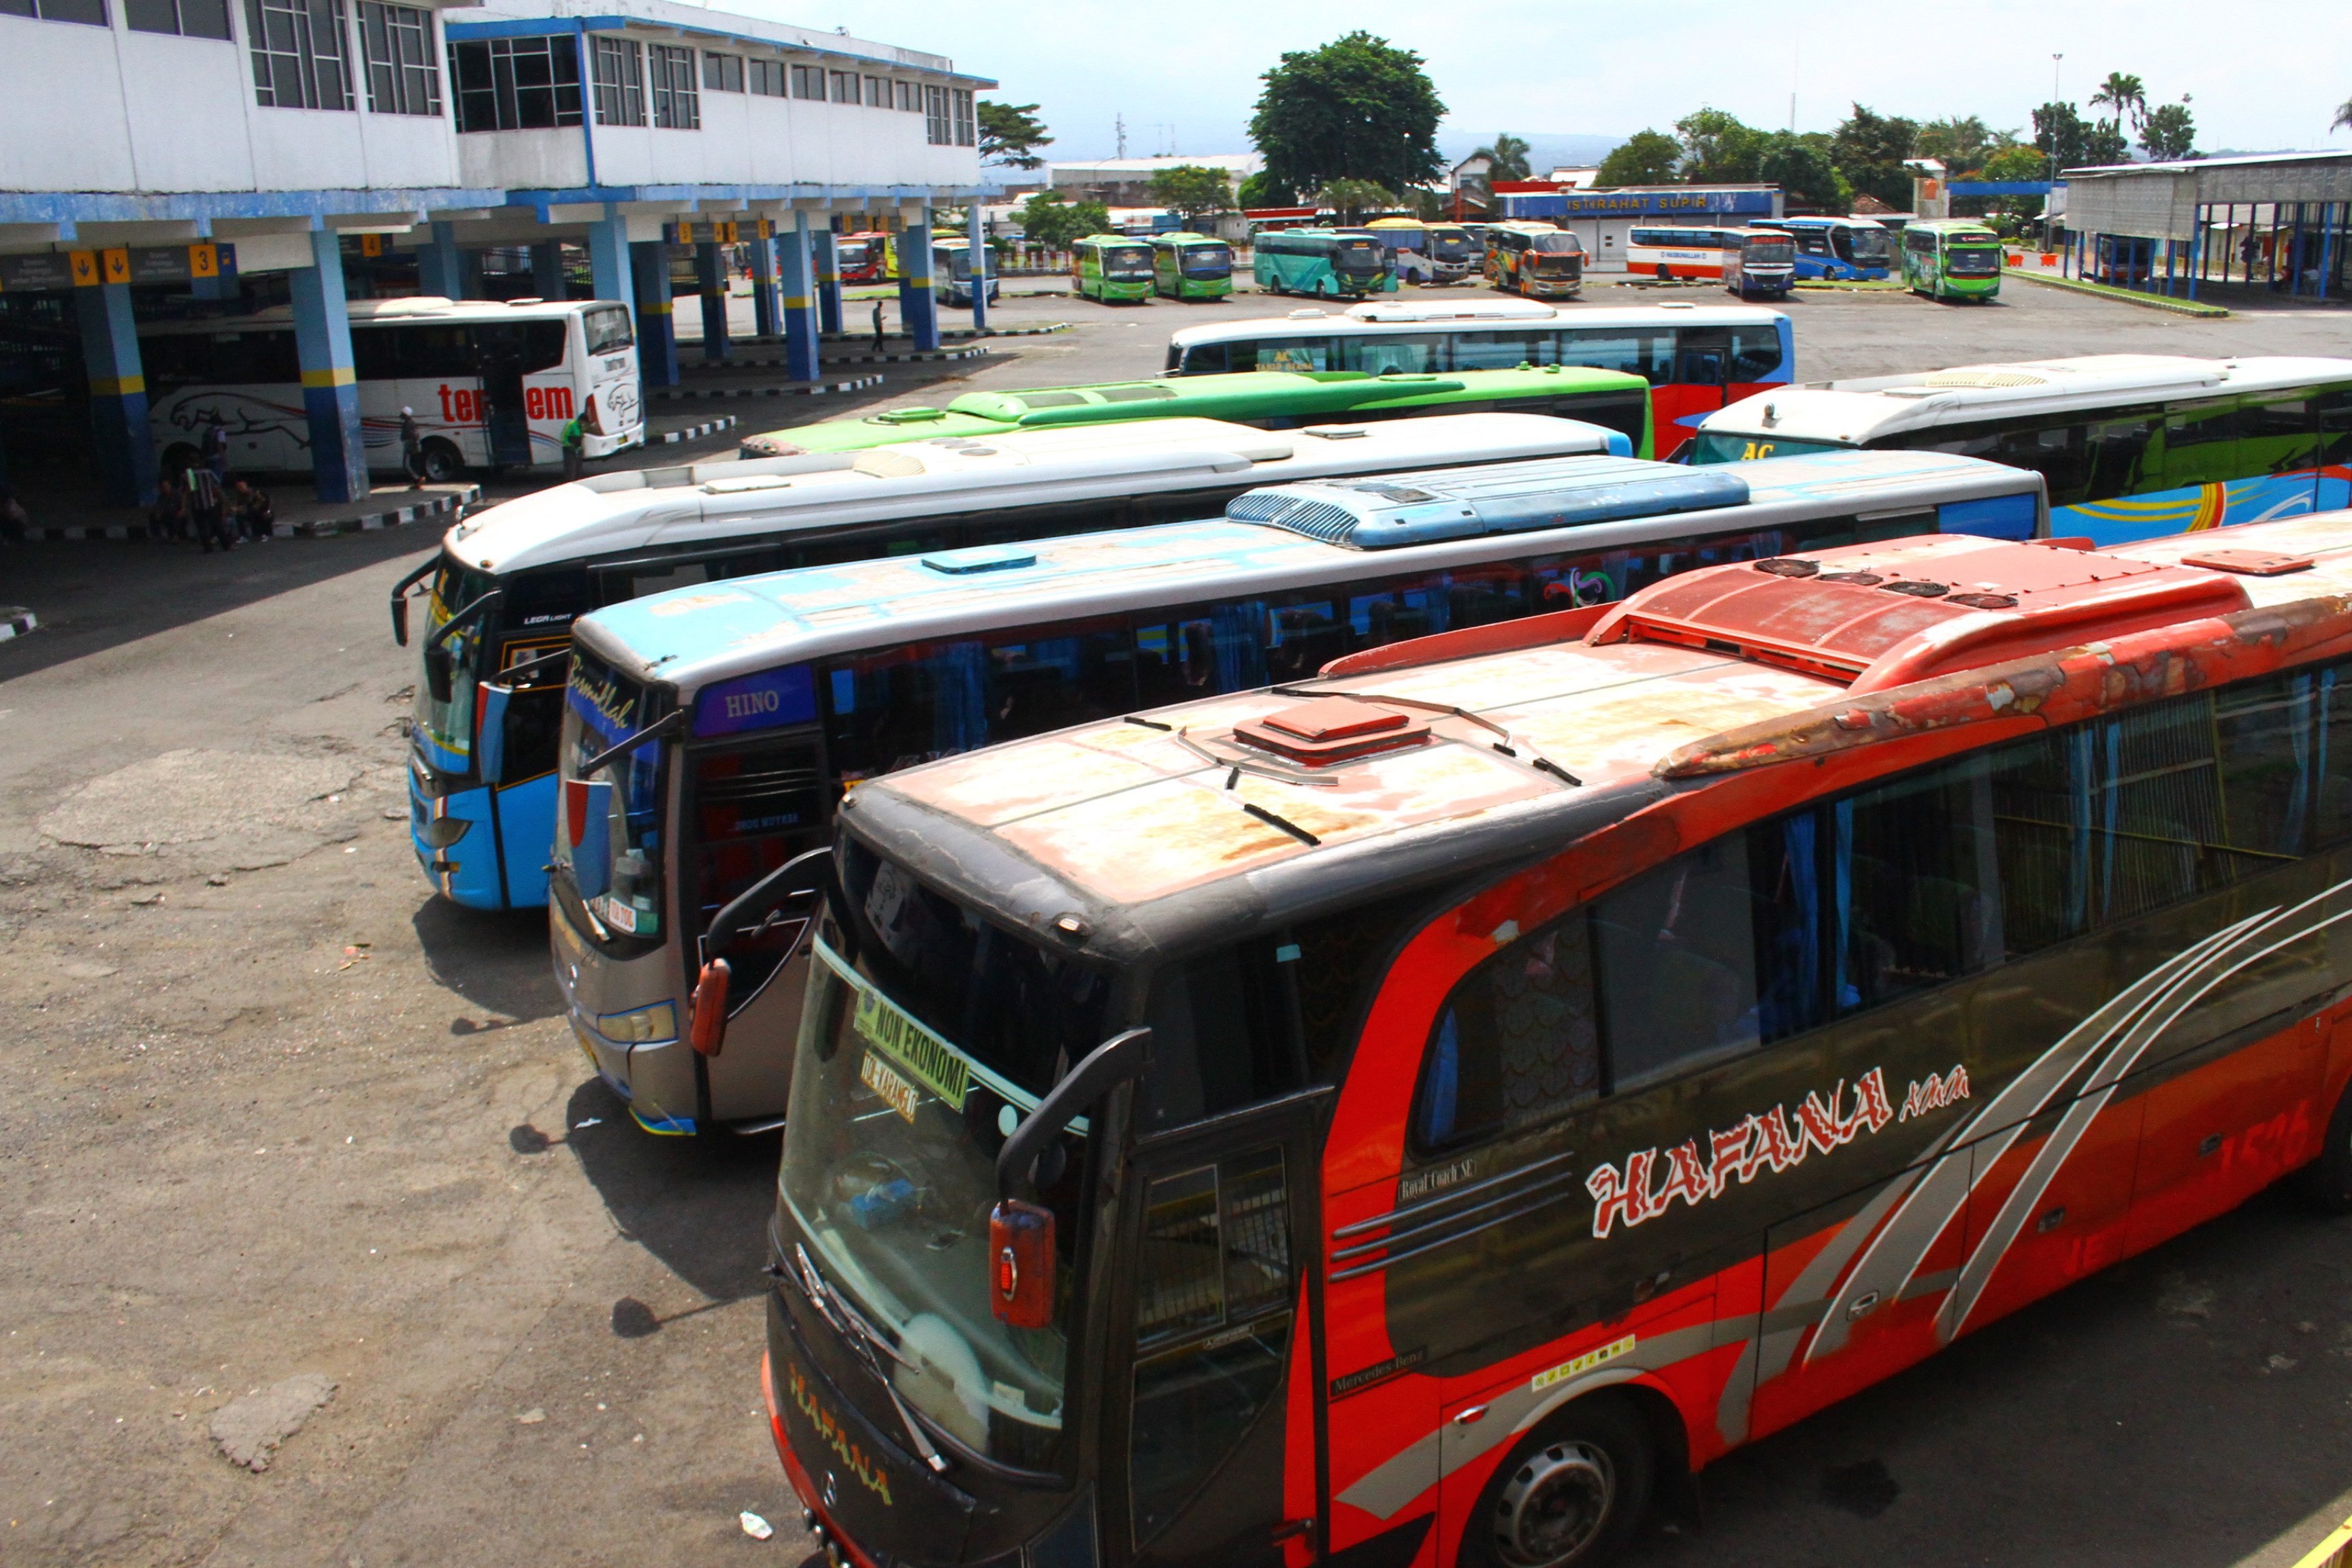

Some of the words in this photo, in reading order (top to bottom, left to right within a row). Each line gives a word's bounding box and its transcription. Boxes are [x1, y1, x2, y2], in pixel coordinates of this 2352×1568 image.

[1567, 198, 1650, 210] ISTIRAHAT
[1659, 197, 1707, 209] SUPIR
[198, 250, 208, 271] 3
[369, 237, 376, 251] 4
[1740, 442, 1775, 461] AC
[568, 654, 634, 729] Bismillah
[725, 689, 779, 718] HINO
[876, 1001, 904, 1051] NON
[902, 1022, 966, 1099] EKONOMI
[1586, 1066, 1894, 1239] HAFANA
[1402, 1172, 1428, 1200] Royal
[1431, 1164, 1457, 1188] Coach
[1335, 1350, 1424, 1394] Mercedes-Benz
[789, 1362, 893, 1507] HAFANA
